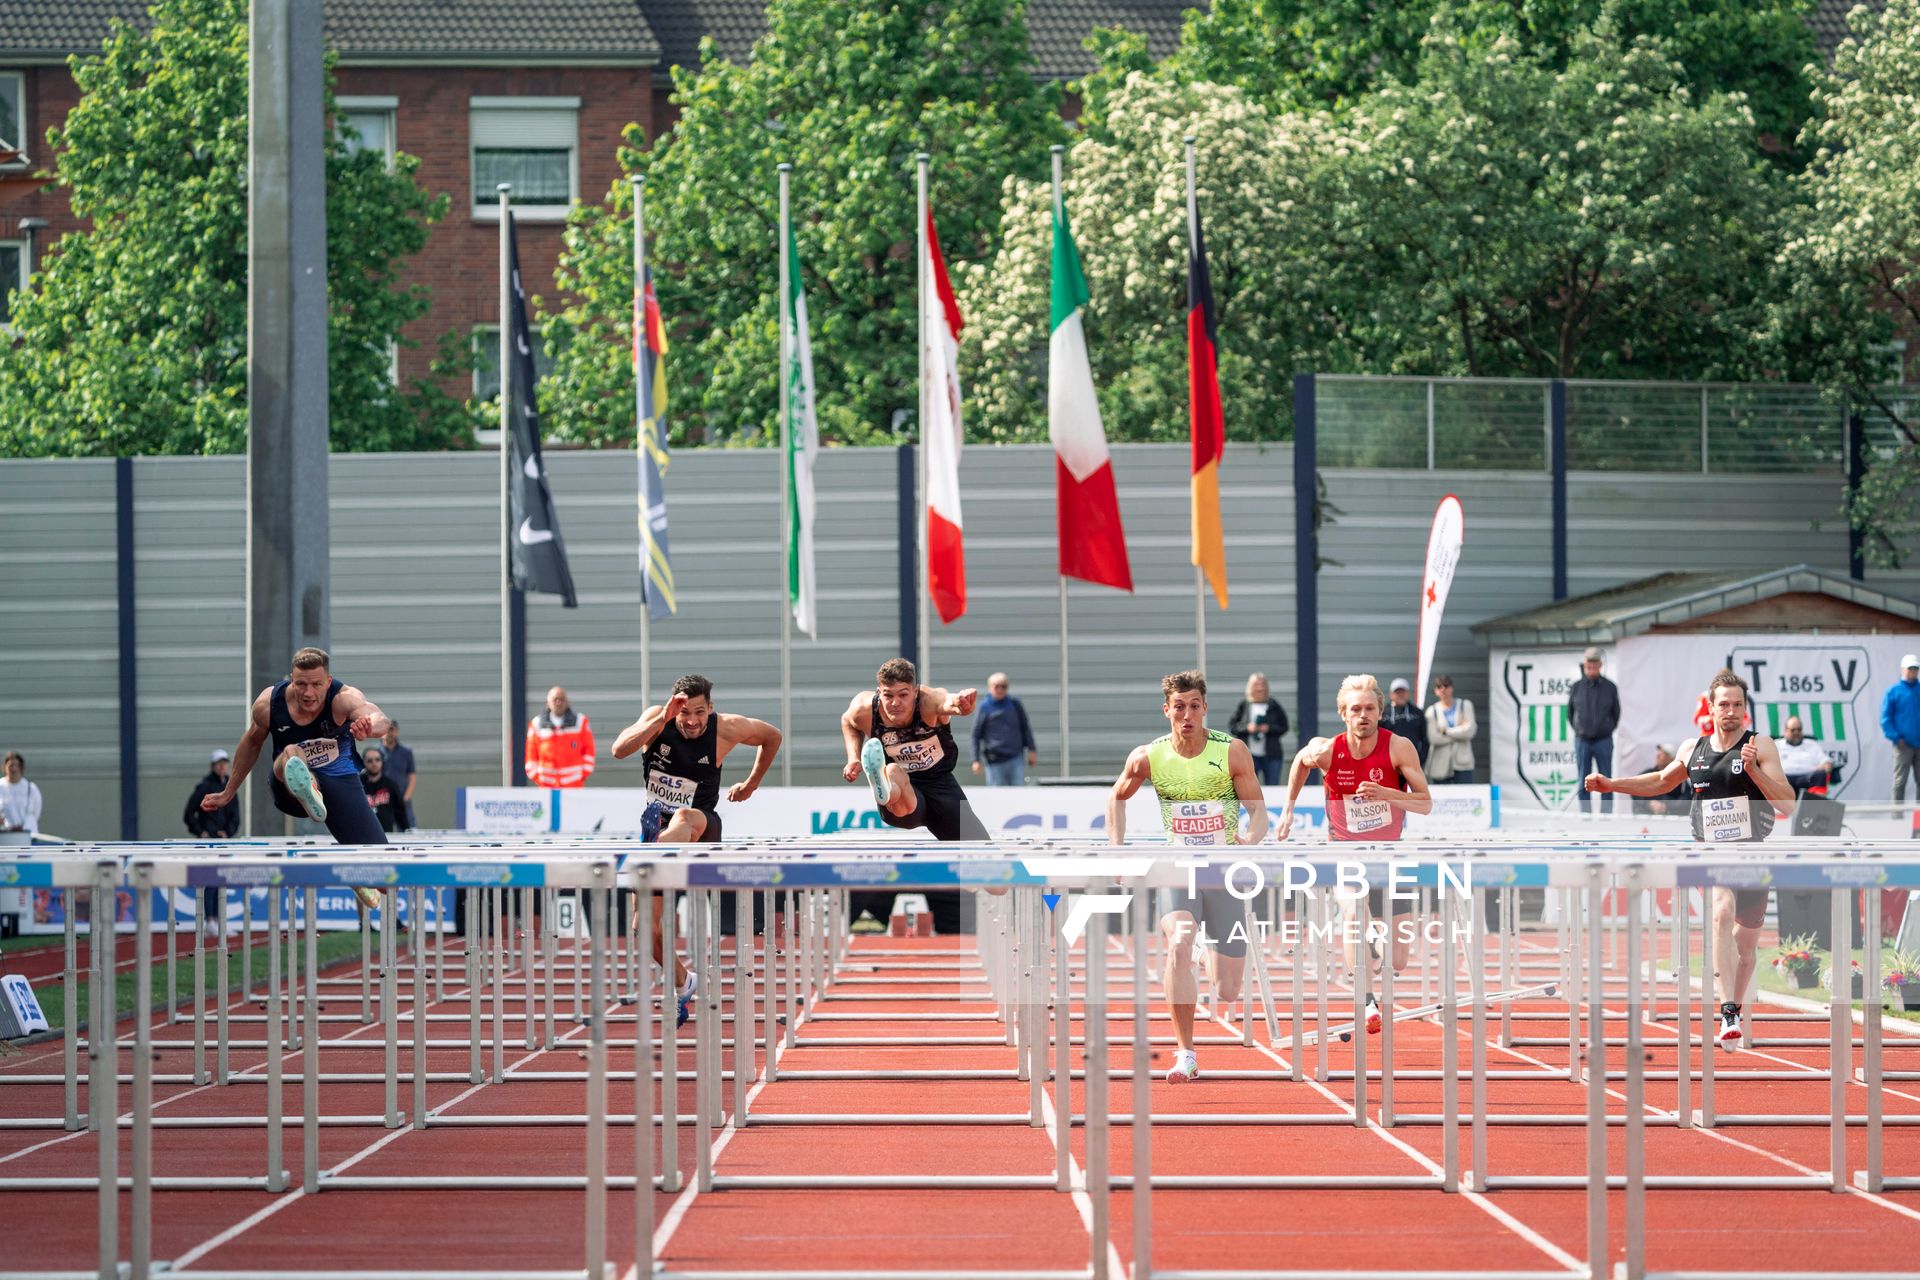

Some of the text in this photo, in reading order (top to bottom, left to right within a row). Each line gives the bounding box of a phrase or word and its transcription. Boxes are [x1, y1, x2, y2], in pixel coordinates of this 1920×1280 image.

[1516, 664, 1572, 695] T 1865
[1744, 659, 1857, 693] T 1865 V
[900, 744, 923, 755] GLS
[659, 776, 683, 789] GLS
[650, 783, 691, 805] NOWAK
[1181, 804, 1208, 816] GLS
[1351, 803, 1388, 818] NILSSON
[1711, 800, 1735, 811] GLS
[1175, 817, 1222, 833] LEADER
[1706, 811, 1748, 827] DIECKMANN
